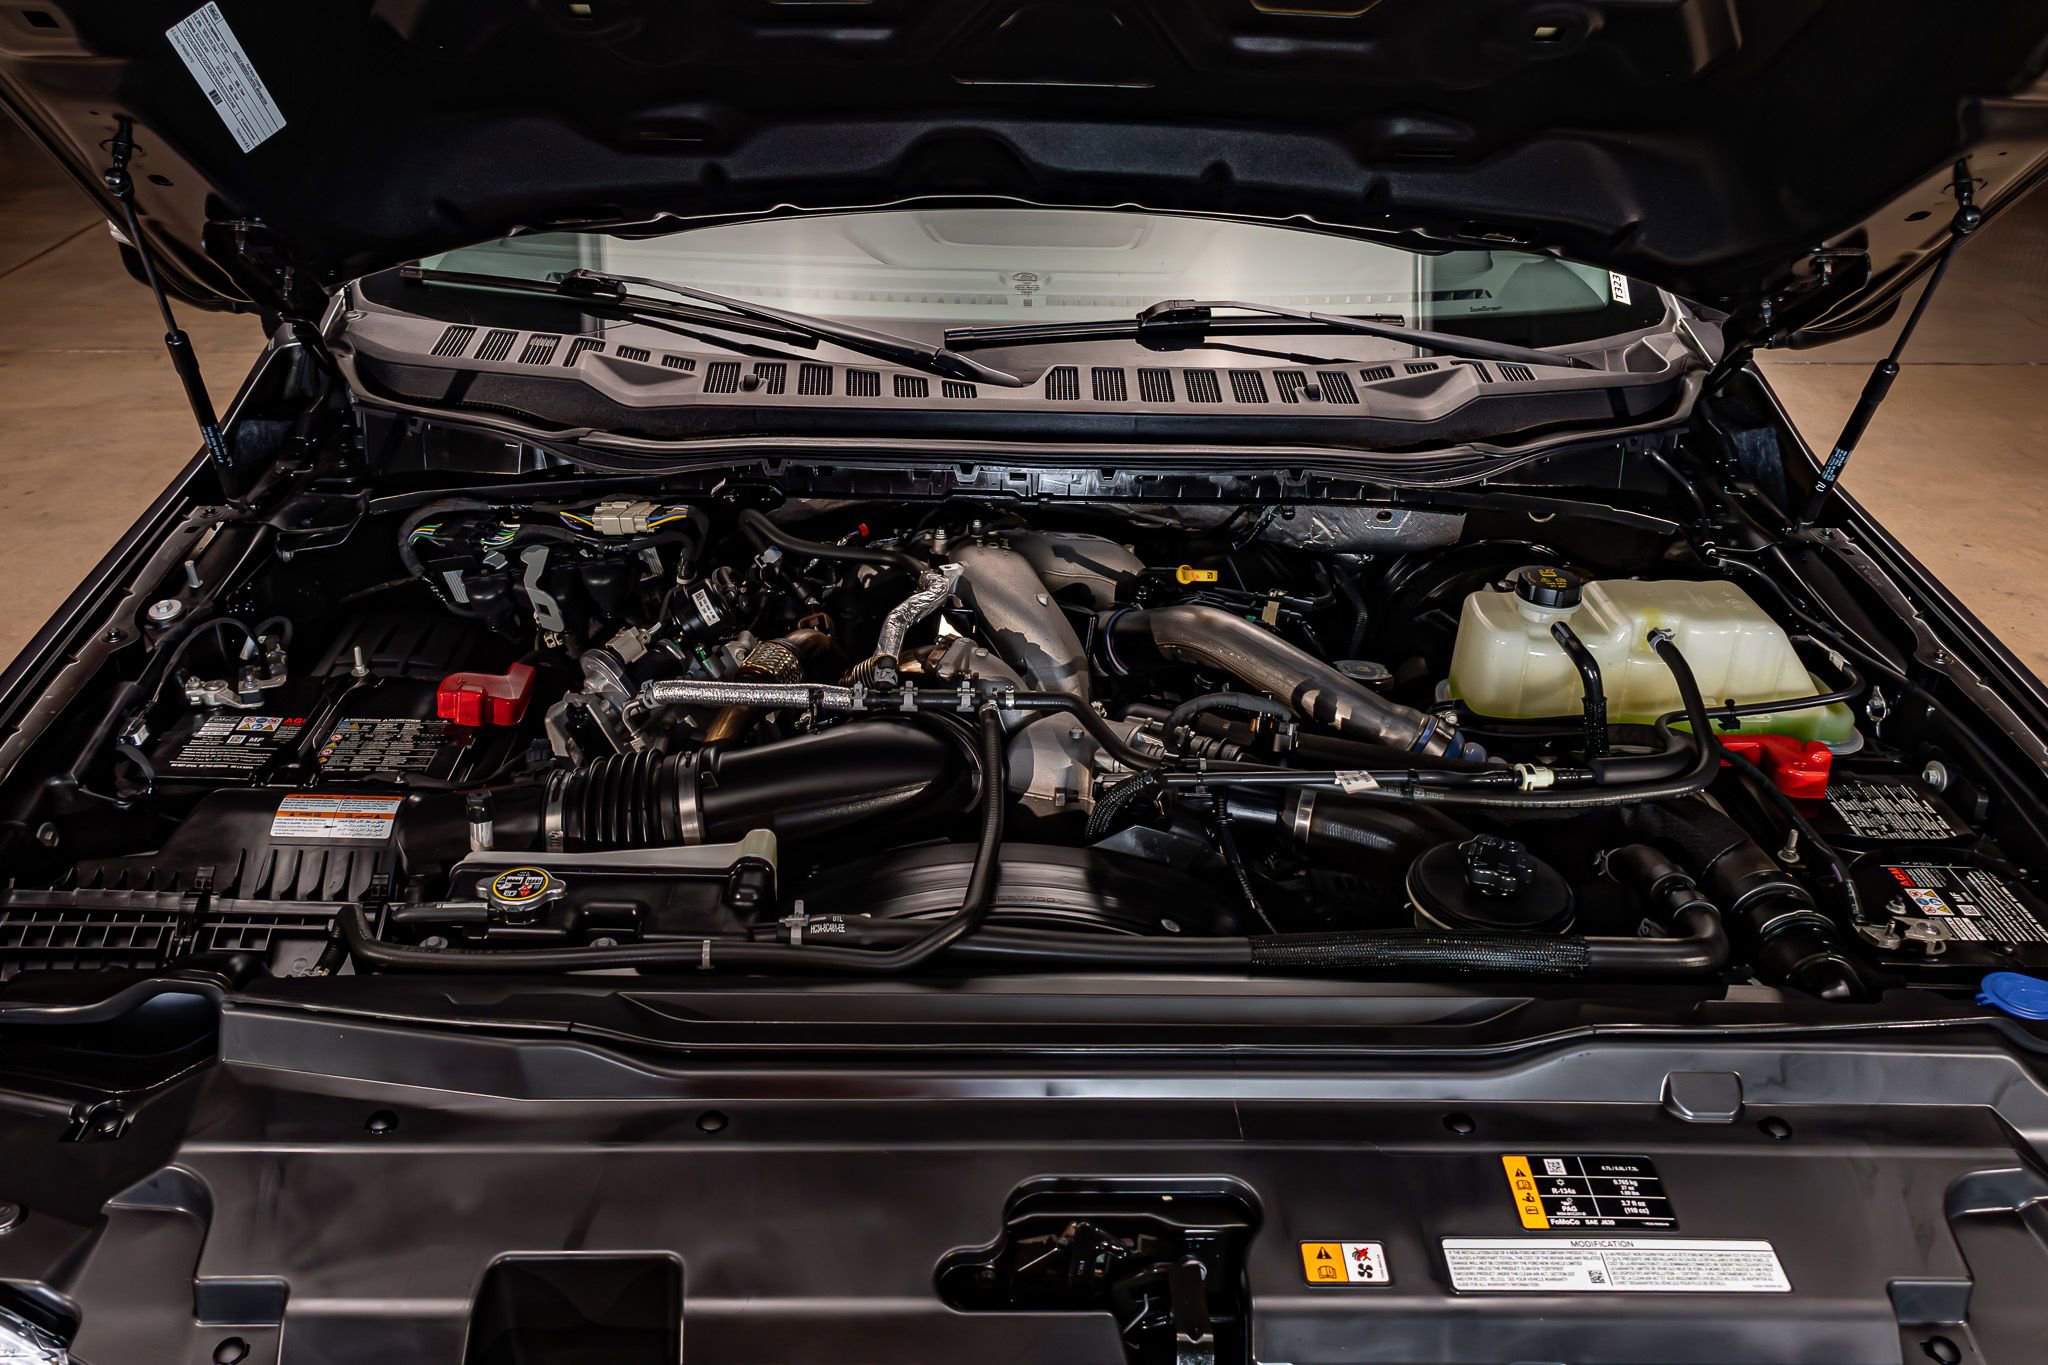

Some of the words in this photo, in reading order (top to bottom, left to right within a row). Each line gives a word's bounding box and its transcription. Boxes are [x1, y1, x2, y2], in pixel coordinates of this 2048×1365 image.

[1612, 274, 1624, 299] T323
[283, 717, 306, 726] AG
[1570, 1240, 1634, 1248] MODIFICATION
